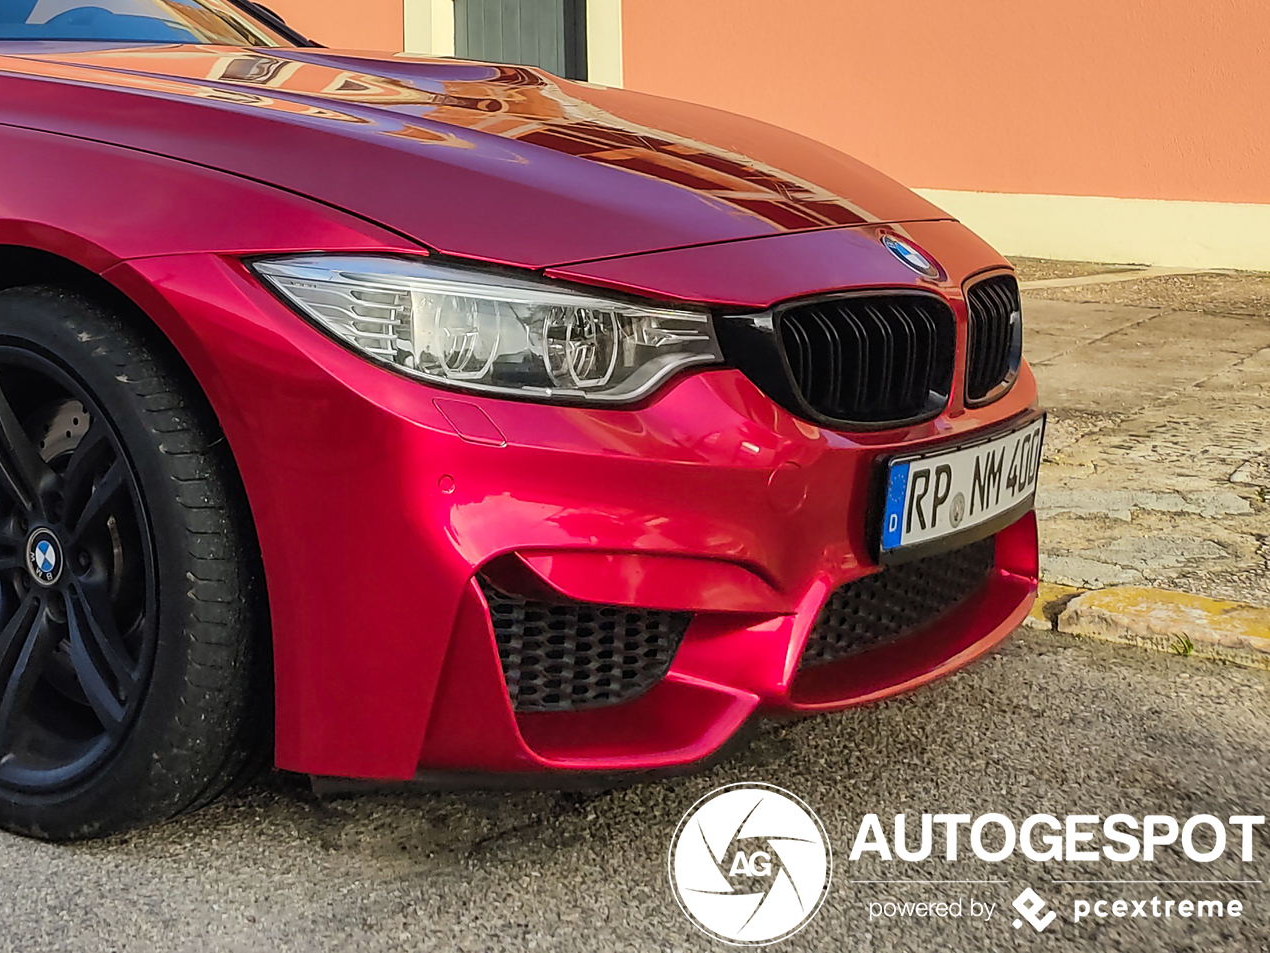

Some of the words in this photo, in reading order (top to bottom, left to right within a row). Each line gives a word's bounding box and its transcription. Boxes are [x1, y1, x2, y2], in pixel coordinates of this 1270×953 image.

[906, 463, 952, 534] RP
[969, 445, 1006, 516] NM
[1006, 427, 1041, 497] 400
[889, 513, 898, 532] D
